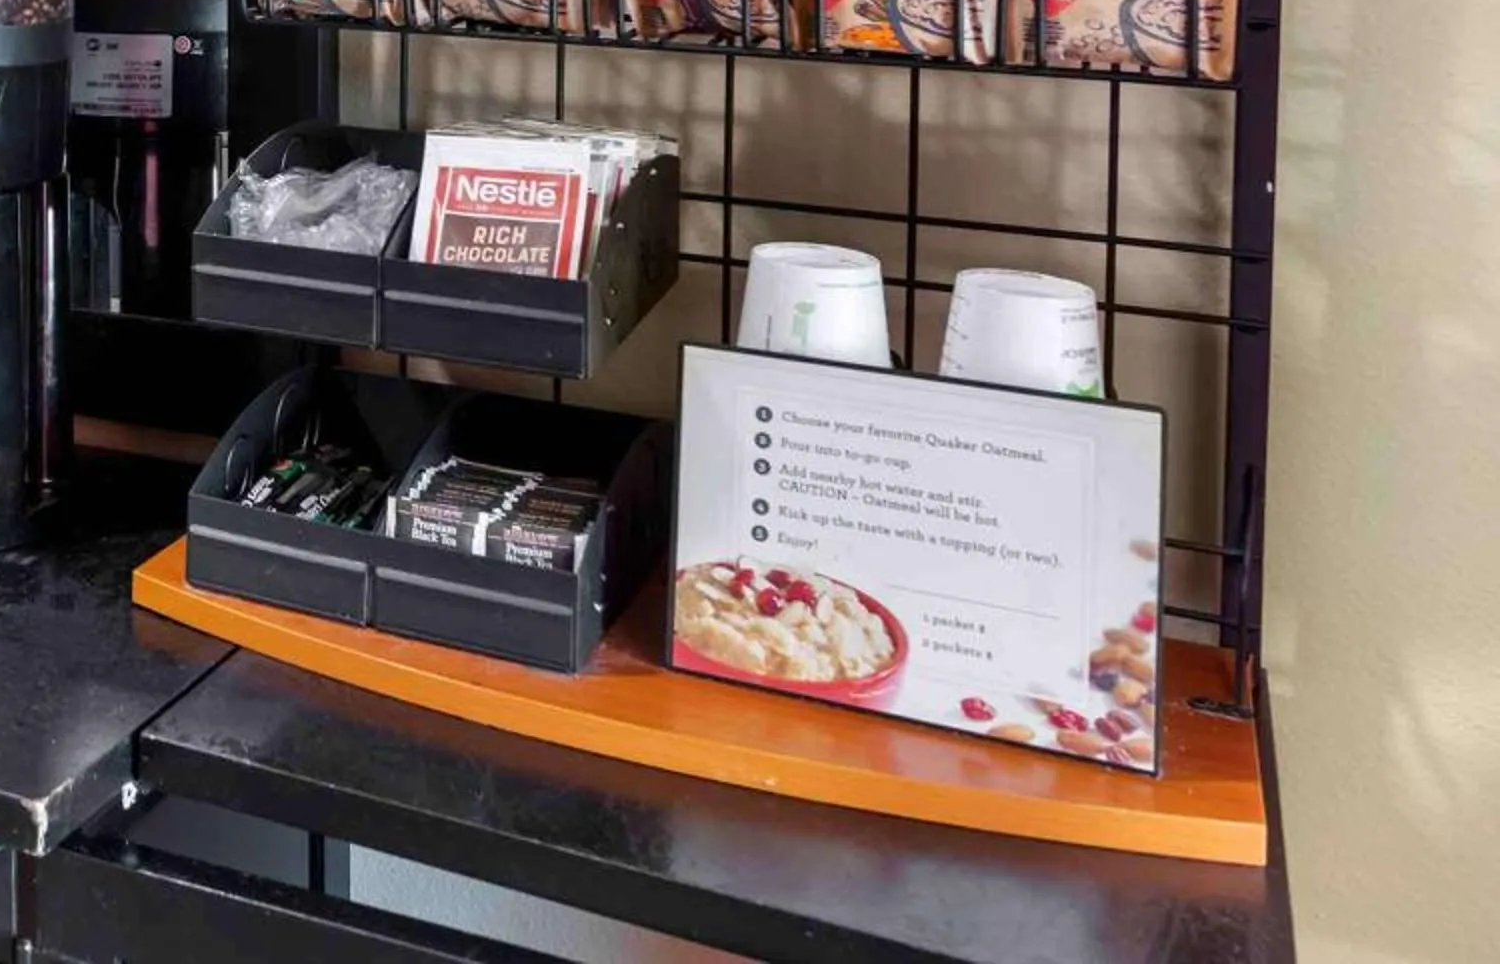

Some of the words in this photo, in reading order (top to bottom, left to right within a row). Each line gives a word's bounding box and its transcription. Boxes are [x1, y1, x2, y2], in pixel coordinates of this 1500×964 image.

[443, 245, 550, 263] CHOCOLATE
[473, 225, 528, 244] RICH
[781, 410, 830, 428] Choose
[834, 420, 864, 434] your
[868, 422, 922, 443] favorite
[925, 433, 978, 453] Quaker
[778, 463, 807, 479] Add
[809, 470, 856, 488] nearby
[859, 475, 882, 491] hot
[885, 484, 923, 496] water
[927, 491, 954, 504] and
[778, 478, 849, 501] CAUTION
[862, 493, 922, 514] Oatmeal
[924, 504, 951, 520] will
[954, 509, 971, 523] be
[413, 517, 457, 536] Premium
[778, 505, 808, 521] Kick
[812, 514, 829, 526] up
[832, 515, 854, 529] the
[858, 521, 891, 535] taste
[894, 528, 925, 542] with
[940, 535, 997, 557] topping
[1000, 544, 1021, 560] (or
